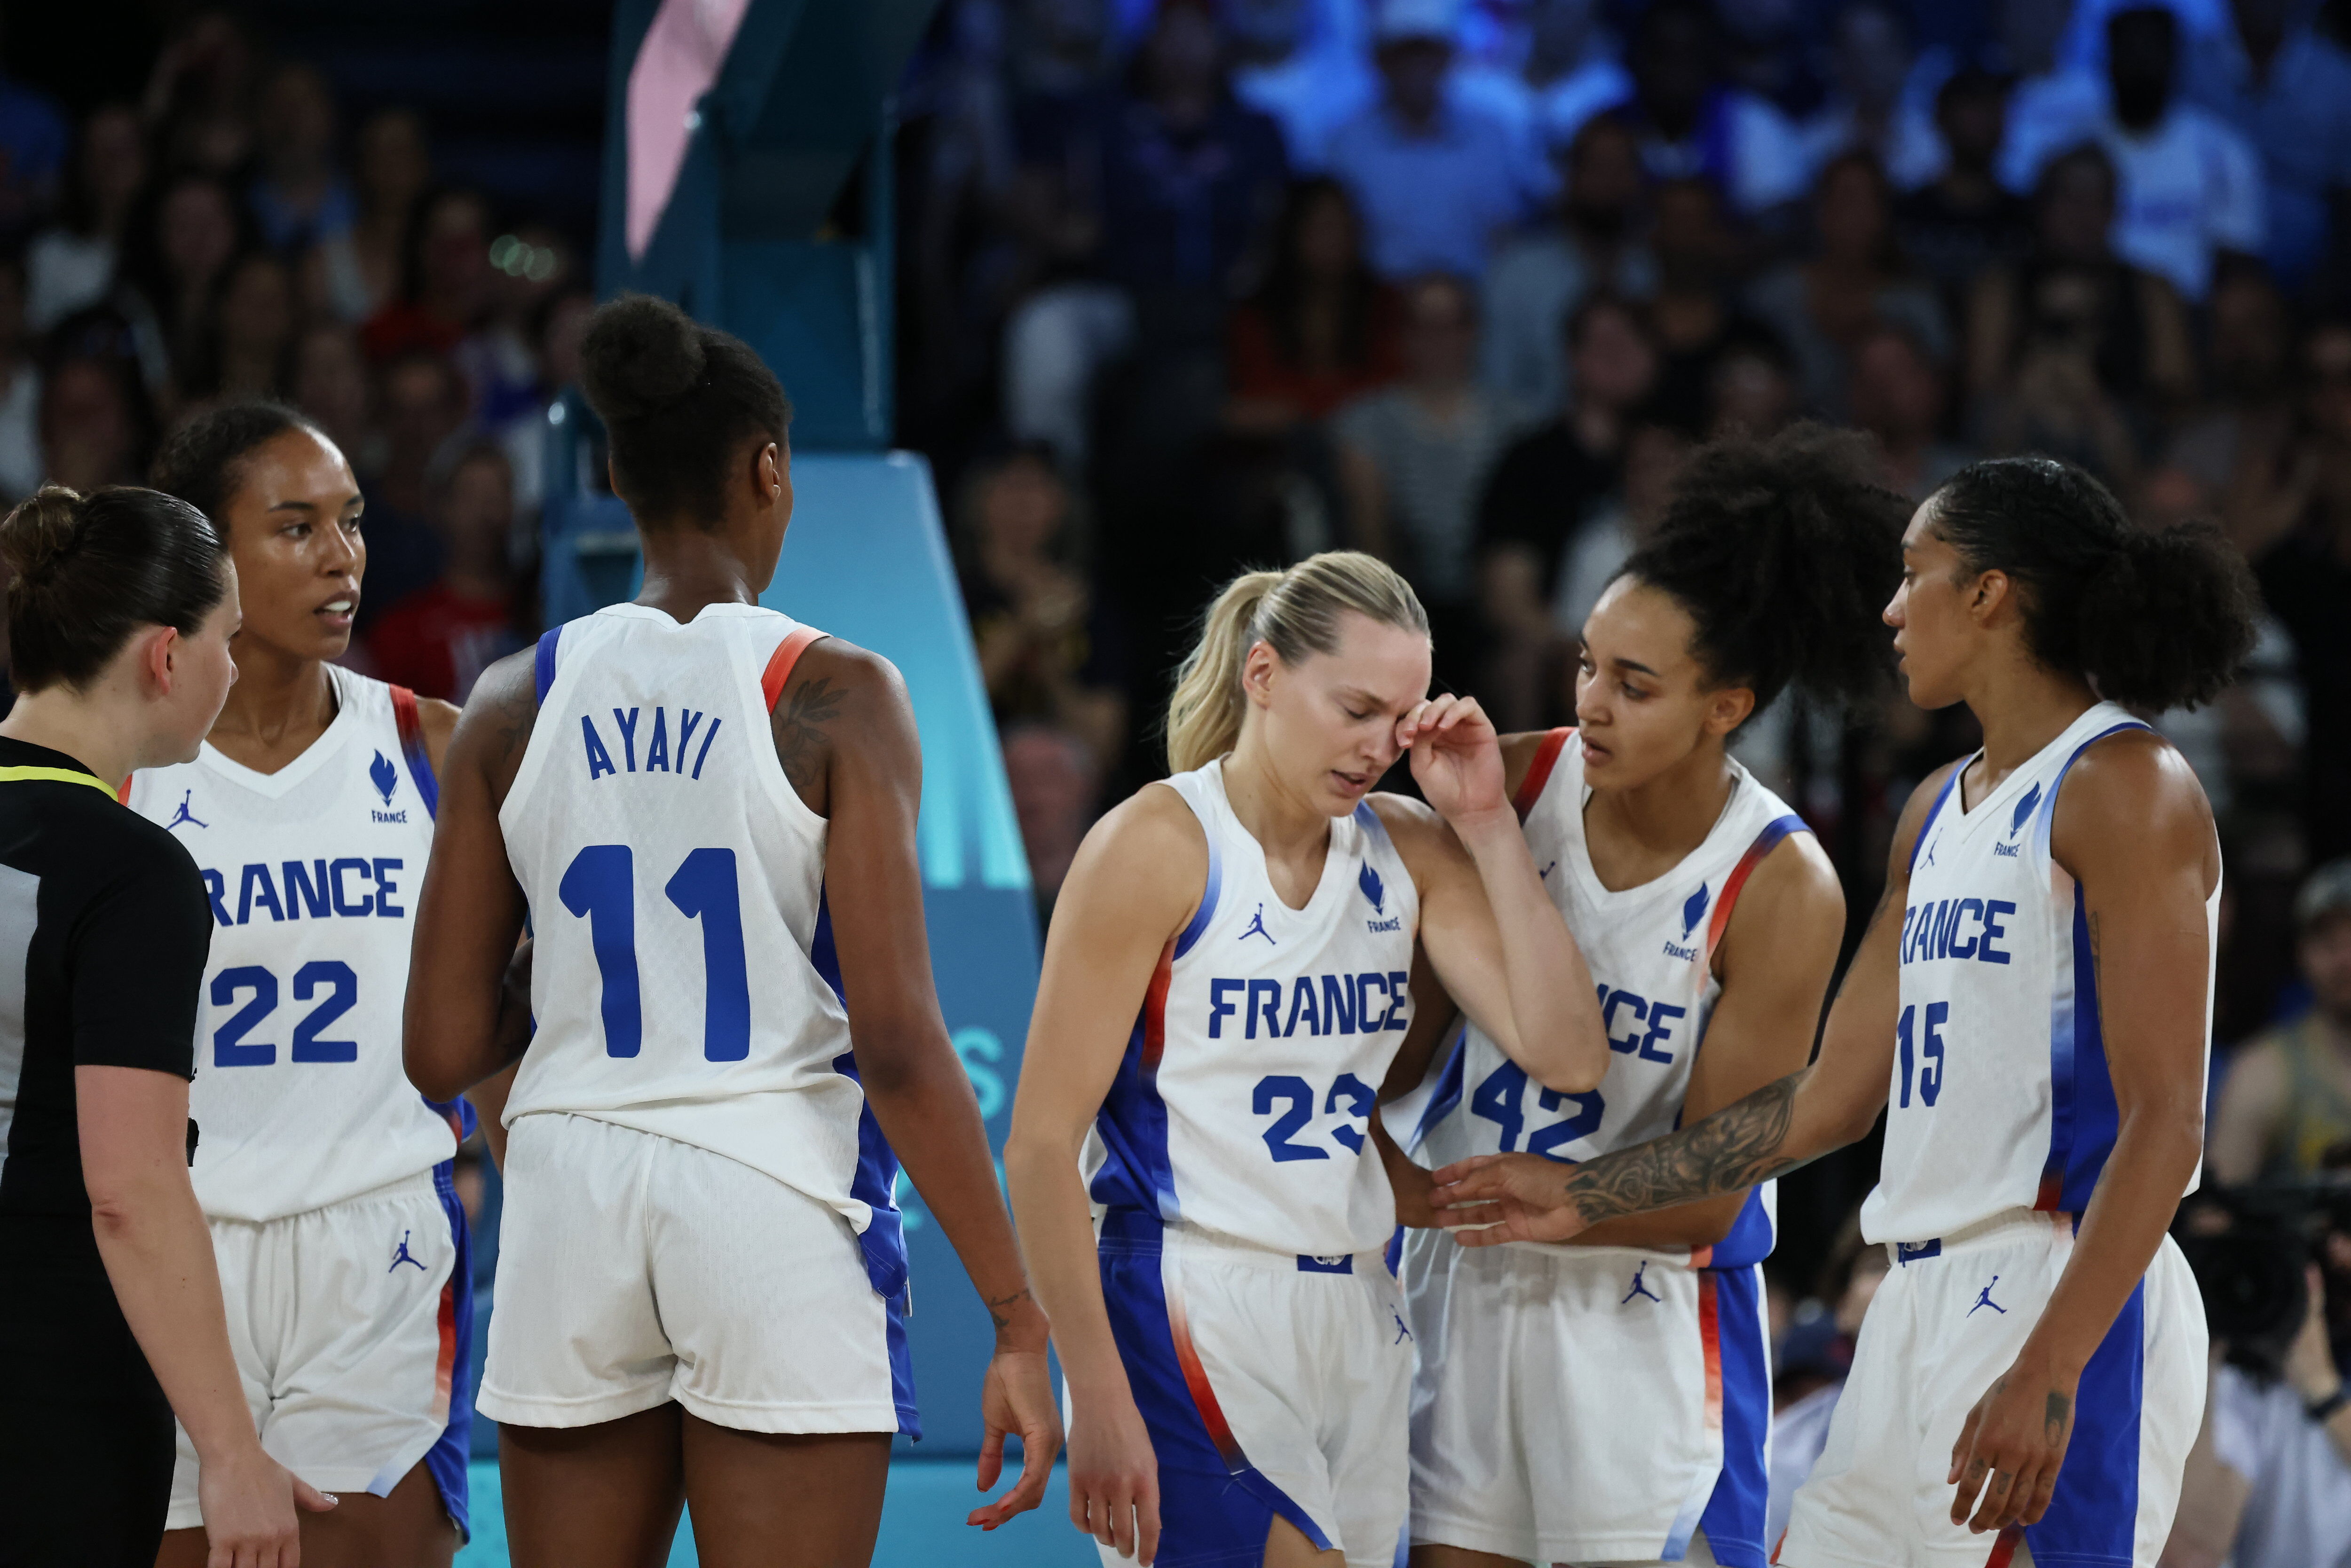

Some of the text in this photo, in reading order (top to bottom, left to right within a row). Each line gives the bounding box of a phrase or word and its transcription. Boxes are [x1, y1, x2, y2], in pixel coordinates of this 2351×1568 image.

[581, 707, 722, 780] AYAYI
[371, 809, 408, 824] FRANCE
[1994, 841, 2020, 858] FRANCE
[201, 858, 404, 927] RANCE
[1367, 916, 1401, 934] FRANCE
[559, 844, 751, 1062] 11
[1663, 941, 1696, 962] FRANCE
[1900, 898, 2017, 965] RANCE
[210, 961, 358, 1067] 22
[1208, 972, 1409, 1039] FRANCE
[1897, 1001, 1949, 1109] 15
[1252, 1072, 1377, 1163] 23
[1471, 1059, 1605, 1164] 42
